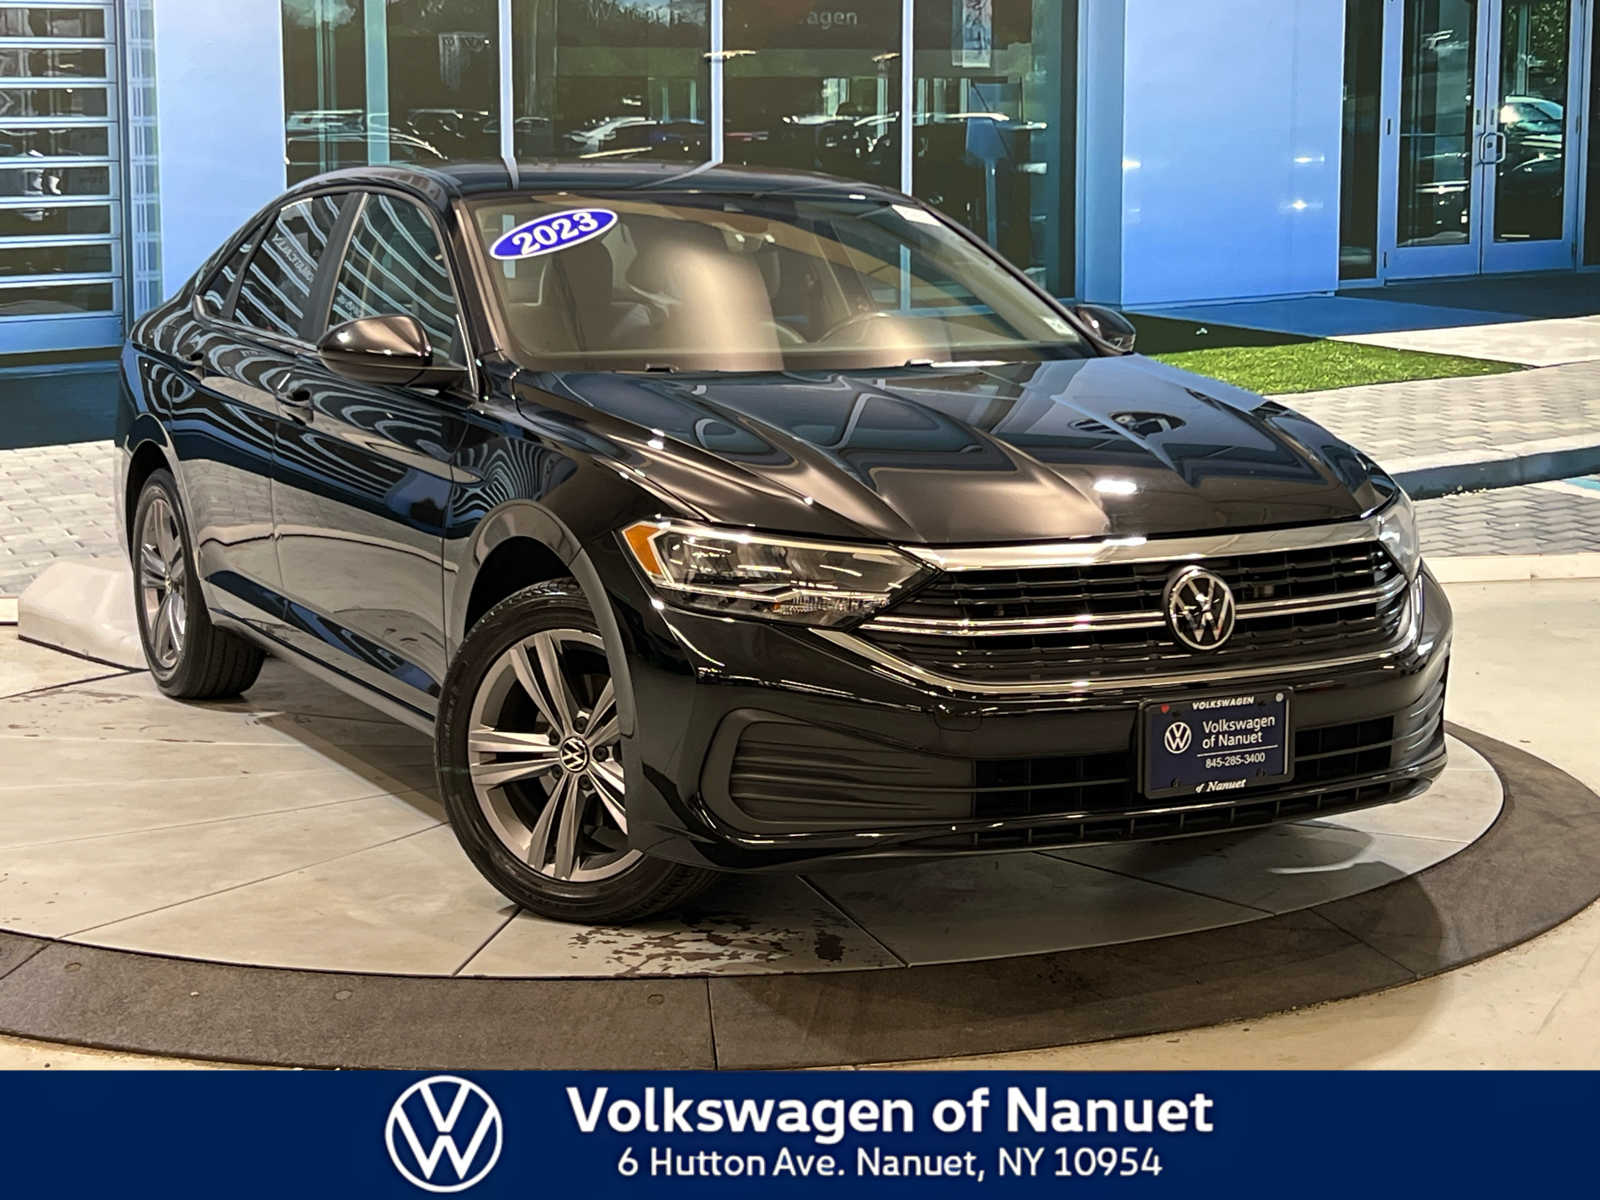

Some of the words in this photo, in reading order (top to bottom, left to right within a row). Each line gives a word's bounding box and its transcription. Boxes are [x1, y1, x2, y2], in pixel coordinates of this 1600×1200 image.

[512, 212, 598, 256] 2023
[1192, 696, 1255, 711] VOLKSWAGEN
[1202, 715, 1275, 734] Volkswagen
[1202, 736, 1215, 749] of
[1218, 731, 1263, 747] Nanuet
[1205, 752, 1266, 769] 845-285-3400
[1195, 783, 1204, 793] of
[1206, 778, 1247, 792] Nanuet
